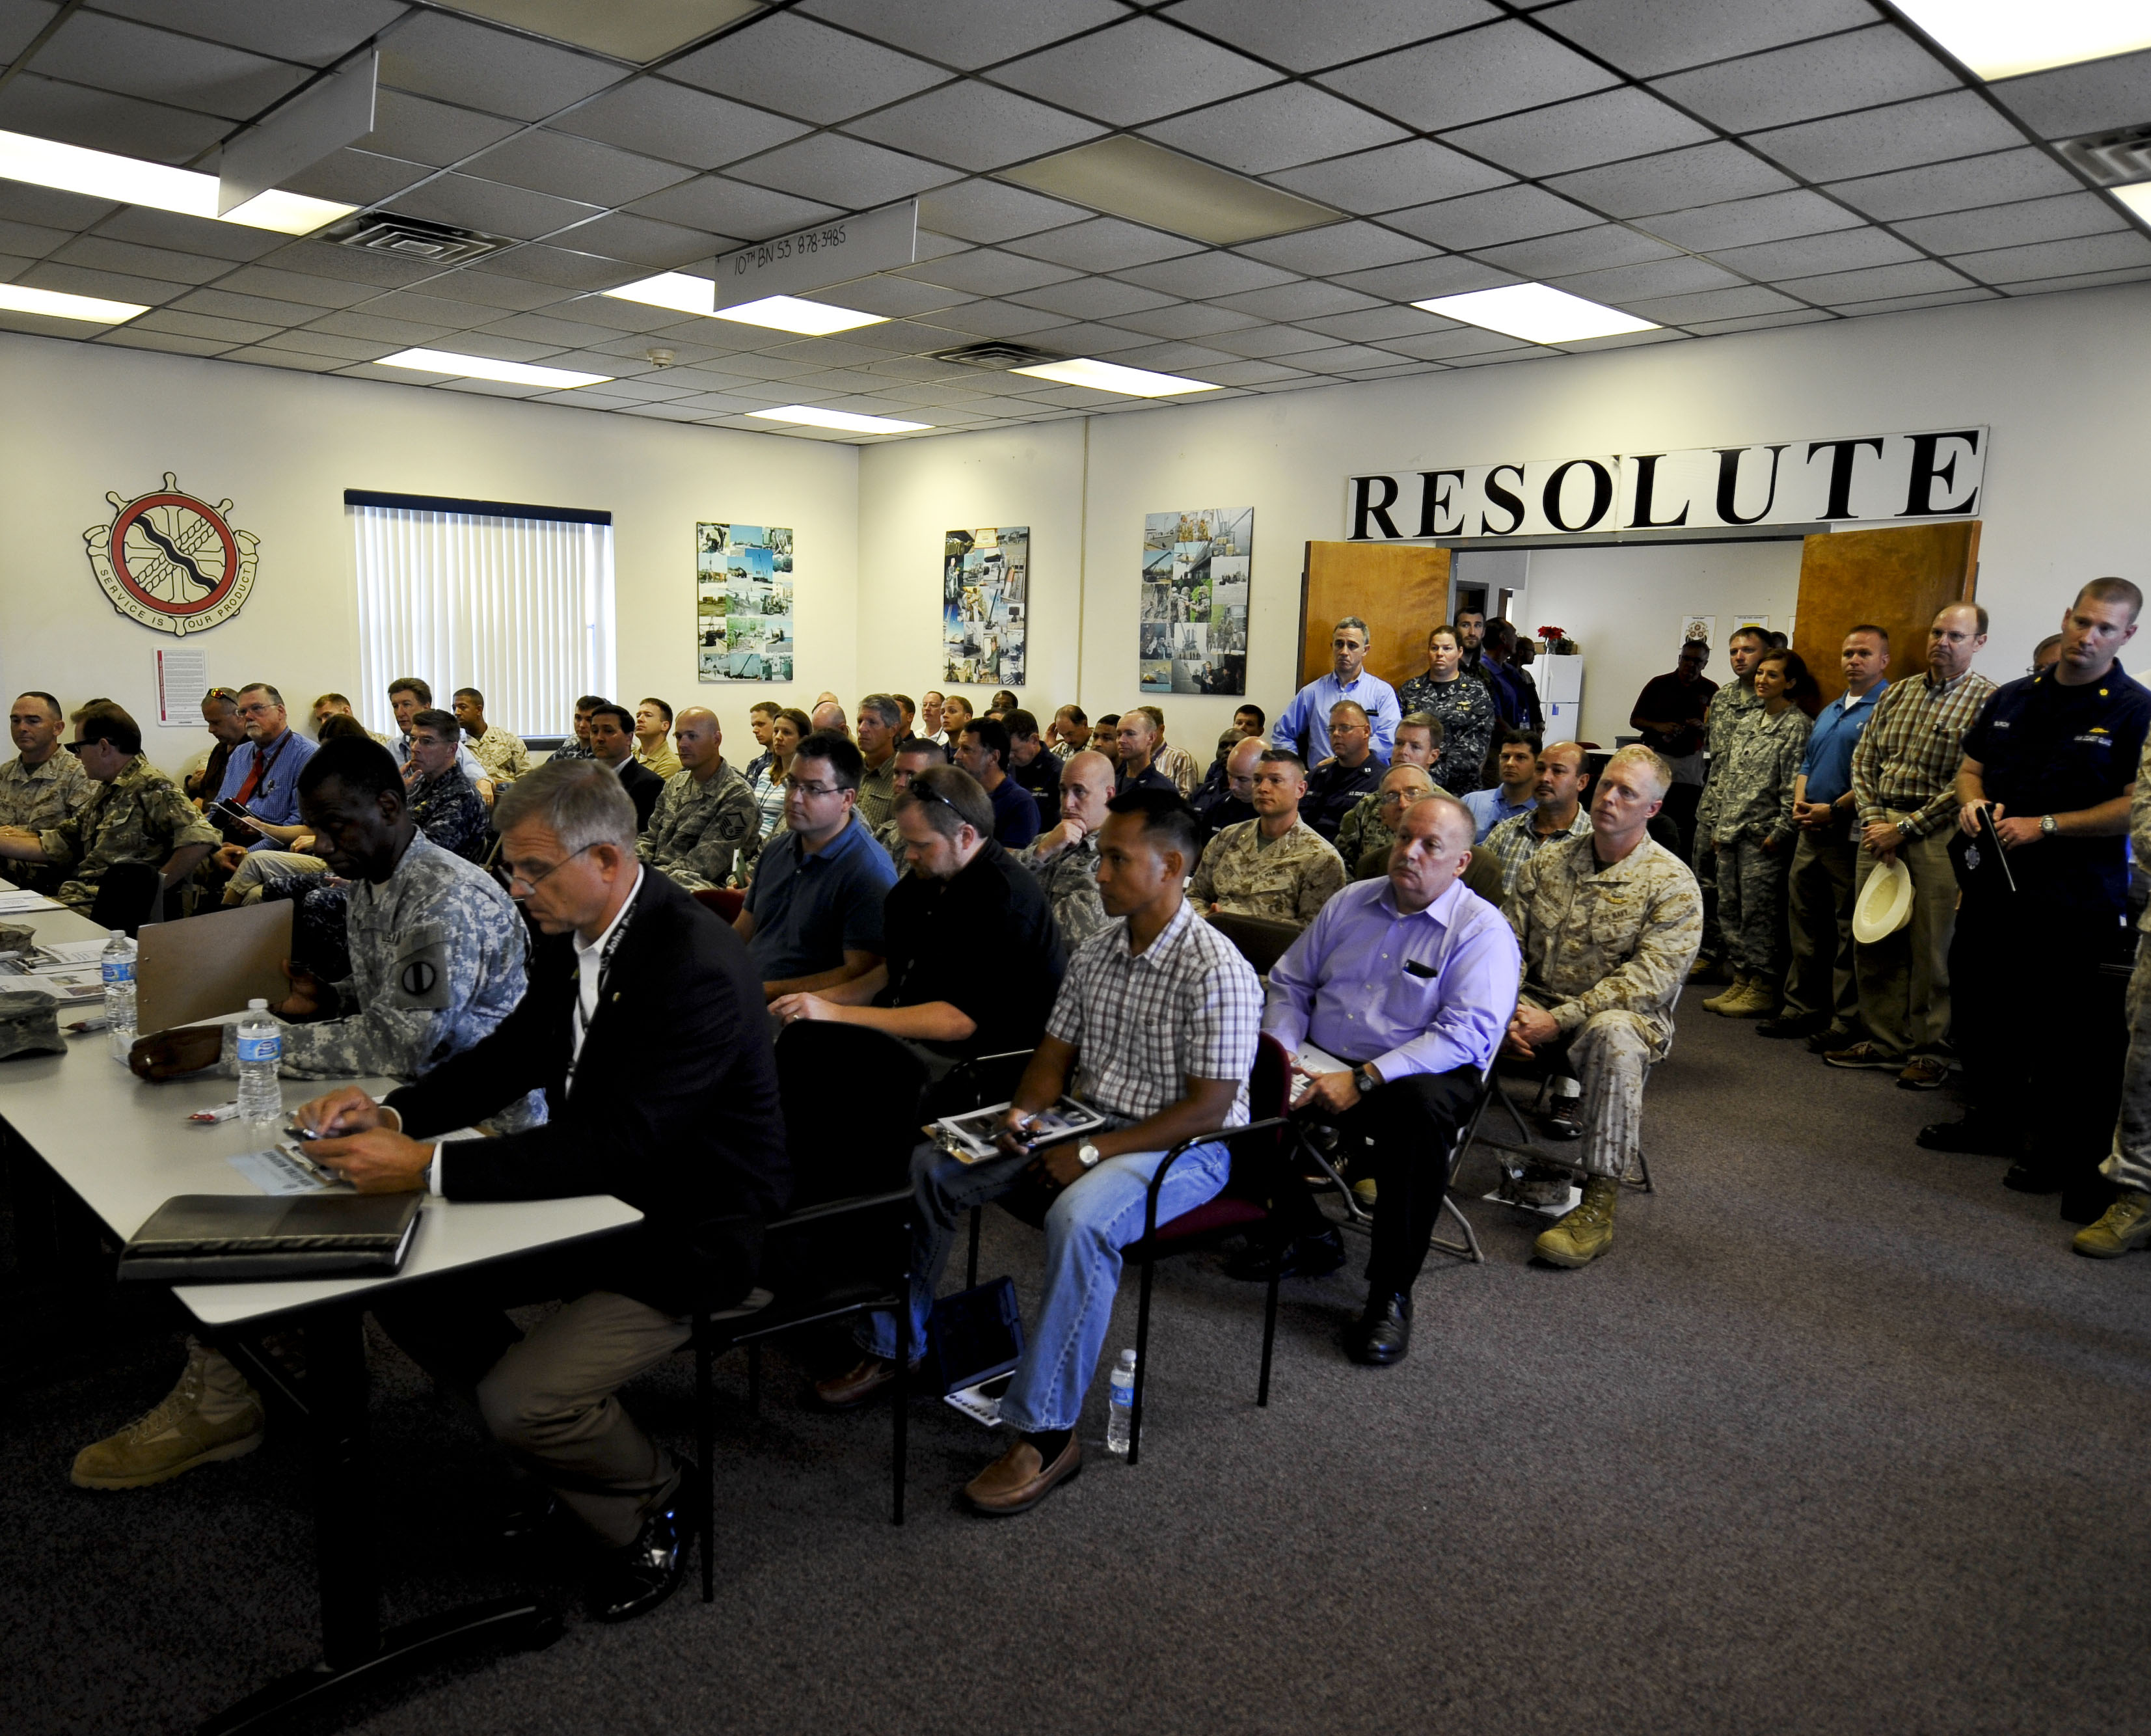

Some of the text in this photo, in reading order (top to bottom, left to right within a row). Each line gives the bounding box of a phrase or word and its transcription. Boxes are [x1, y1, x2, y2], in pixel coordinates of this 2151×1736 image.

[758, 245, 774, 268] BN
[777, 241, 791, 259] S3
[797, 224, 846, 254] 878-3985
[1349, 430, 1979, 540] RESOLUTE
[100, 568, 252, 629] SERVICE IS OUR PRODUCT
[606, 927, 626, 954] John
